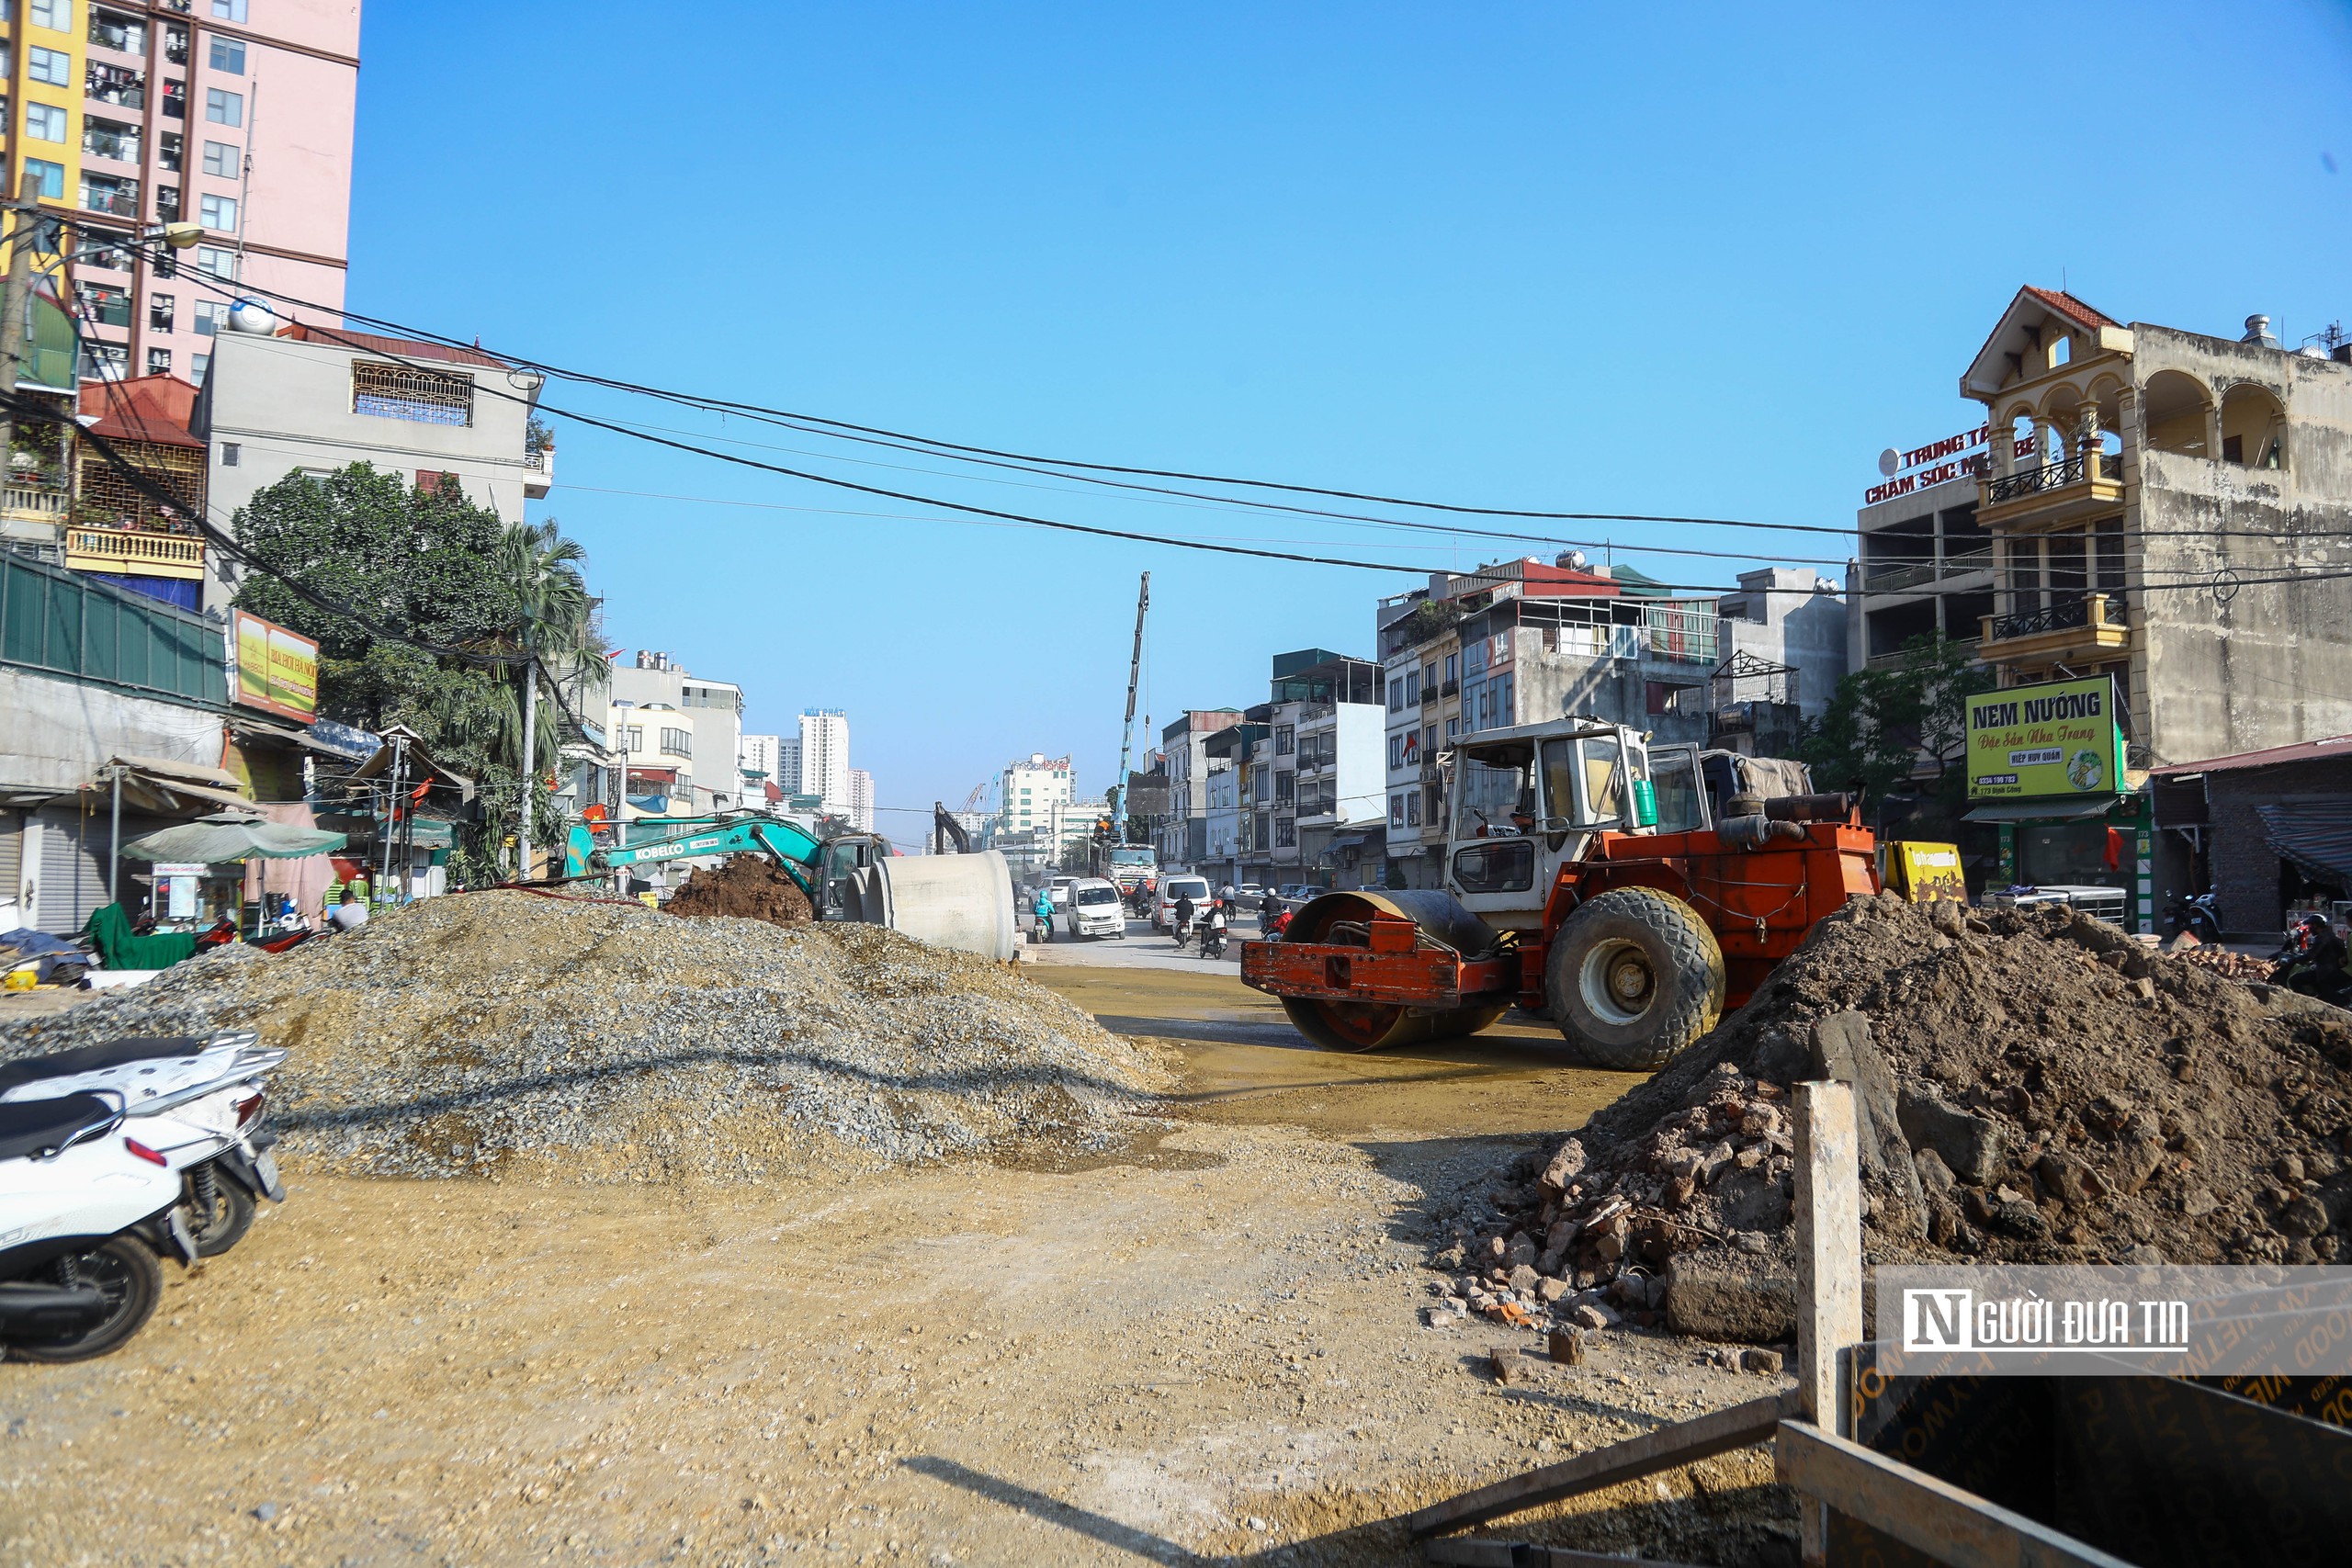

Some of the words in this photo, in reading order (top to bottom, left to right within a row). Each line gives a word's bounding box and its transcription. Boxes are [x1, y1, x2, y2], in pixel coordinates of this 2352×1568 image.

[1903, 434, 1966, 469] TRUNG
[1968, 420, 1989, 447] TÂ
[1973, 702, 2018, 730] NEM
[2024, 691, 2101, 725] NƯỚNG
[2027, 728, 2054, 744] Nha
[2057, 726, 2096, 742] Trang
[635, 843, 684, 861] KOBELCO
